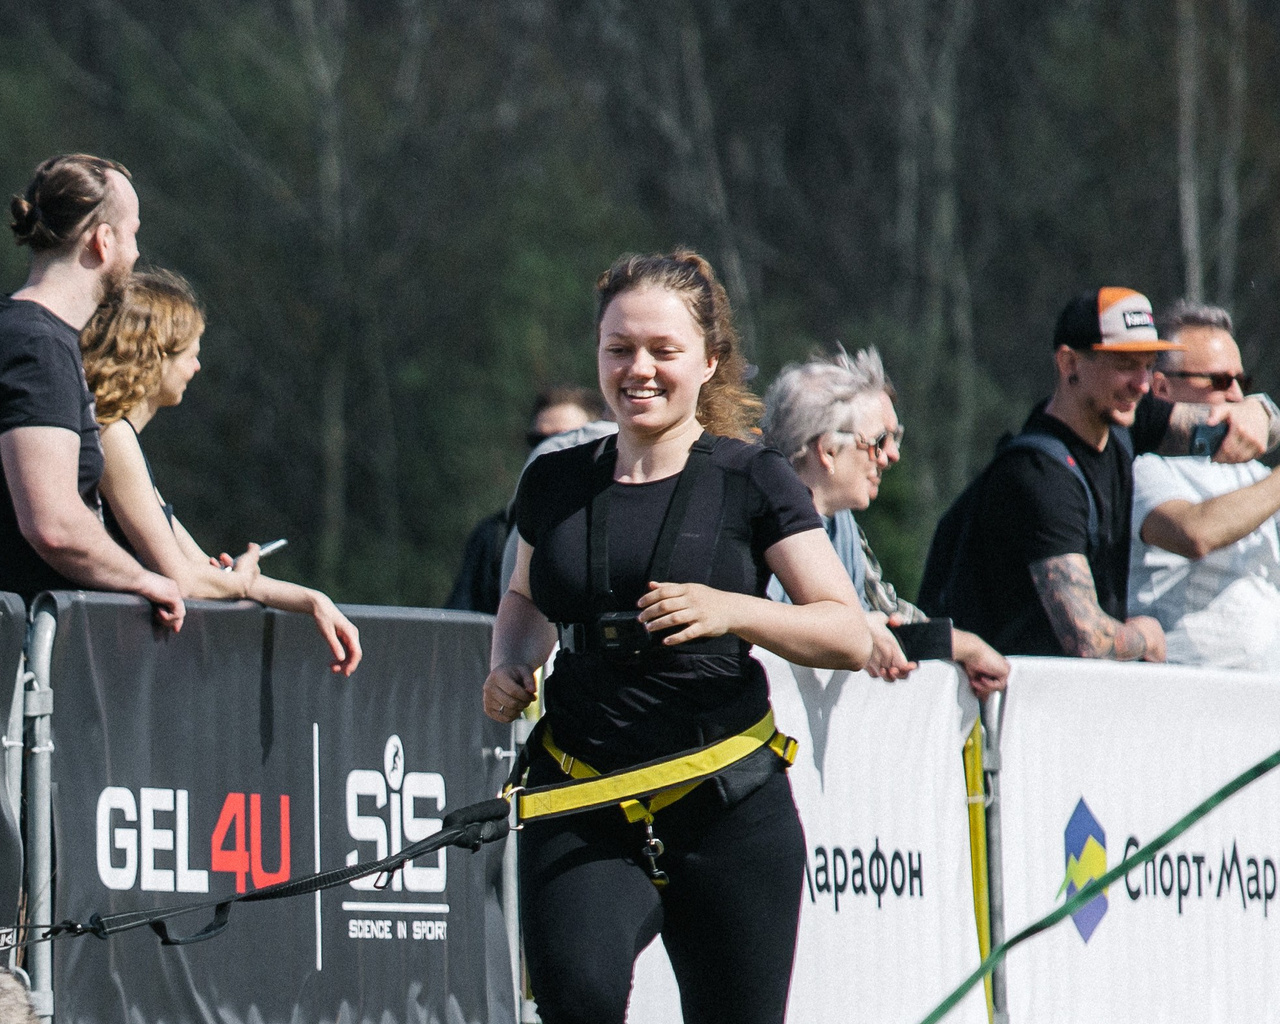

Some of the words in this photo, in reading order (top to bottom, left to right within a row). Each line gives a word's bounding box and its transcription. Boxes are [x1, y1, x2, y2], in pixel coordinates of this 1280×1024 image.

[348, 919, 393, 939] SCIENCE
[397, 920, 407, 939] IN
[412, 920, 447, 940] SPORT
